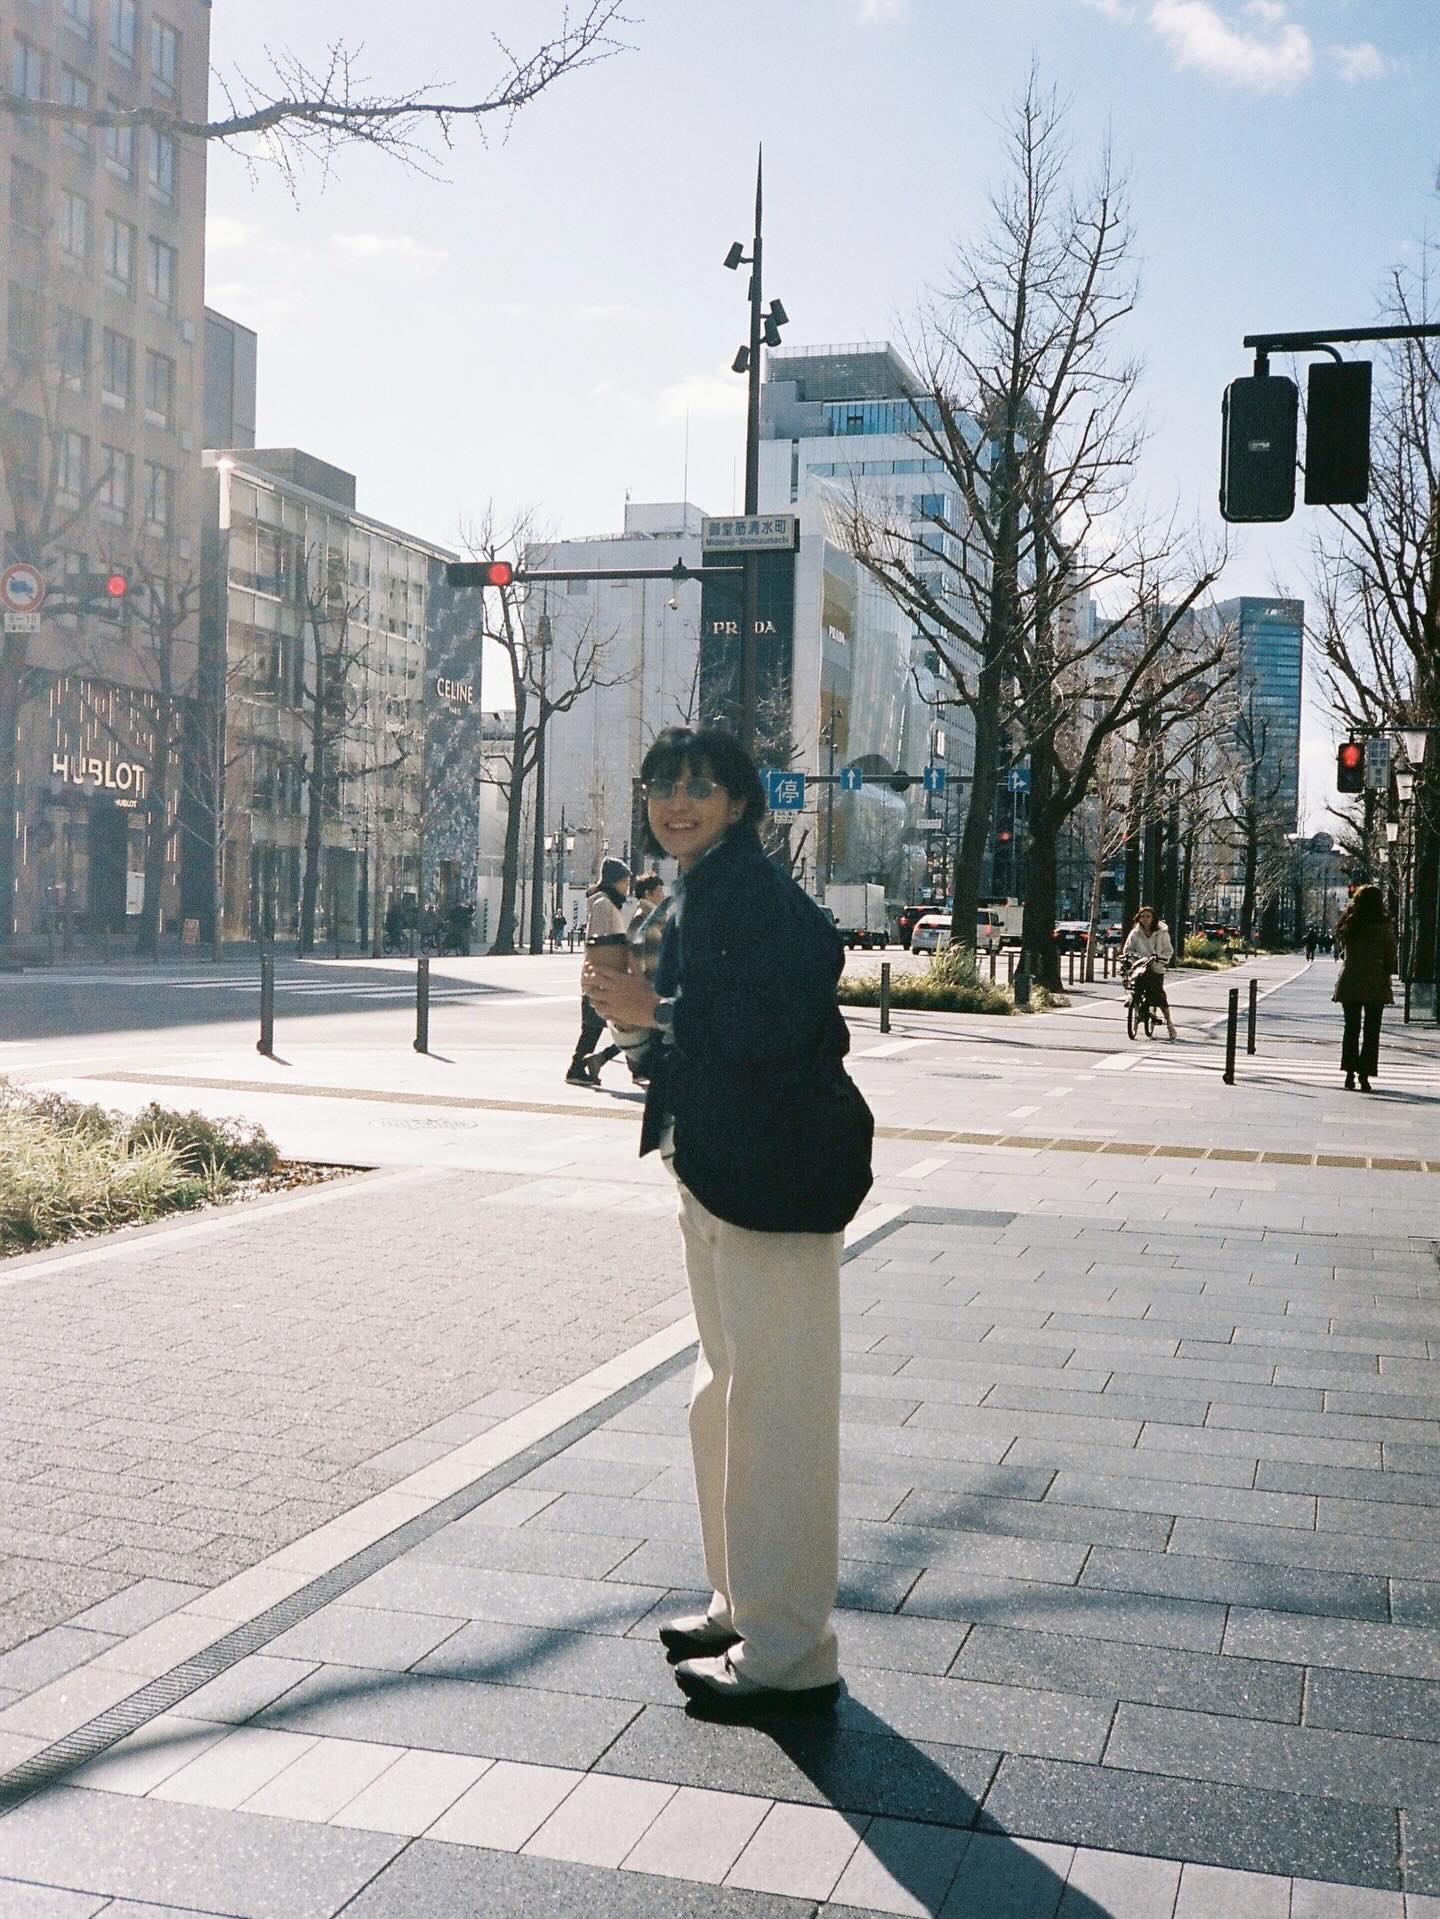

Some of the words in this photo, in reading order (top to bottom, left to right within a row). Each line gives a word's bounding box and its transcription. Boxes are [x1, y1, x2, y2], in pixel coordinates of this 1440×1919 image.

[713, 621, 776, 634] PRDA
[437, 678, 473, 704] CELINE
[52, 753, 145, 791] HUBLOT
[775, 779, 800, 803] 停
